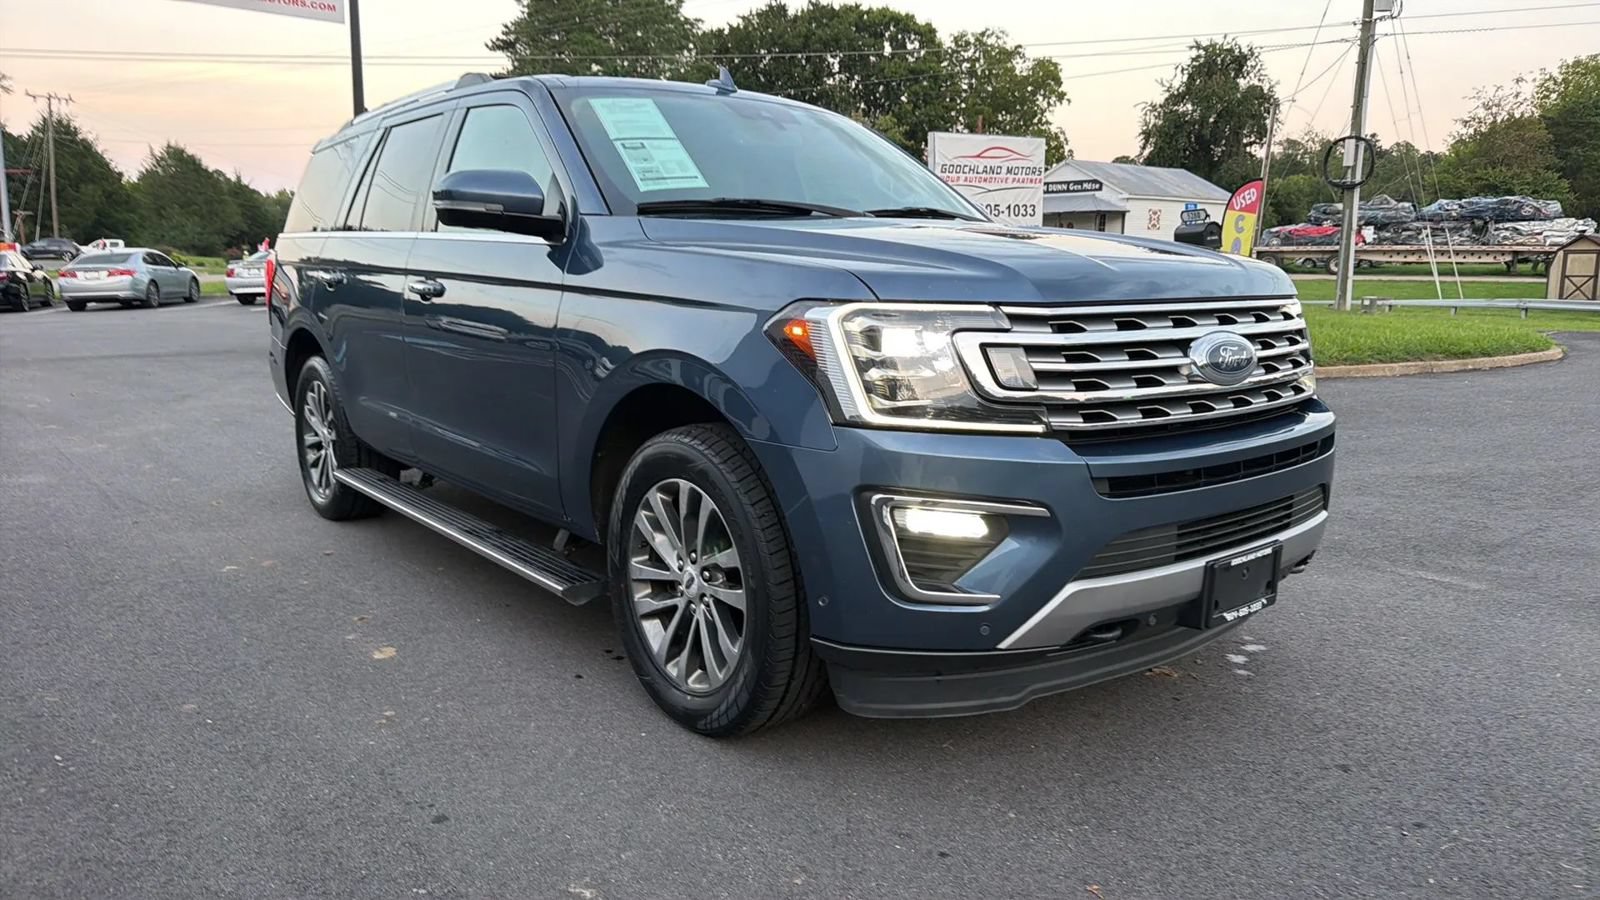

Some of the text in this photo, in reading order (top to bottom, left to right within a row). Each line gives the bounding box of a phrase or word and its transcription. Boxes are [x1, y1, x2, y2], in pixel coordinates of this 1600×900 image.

[940, 163, 1042, 177] GOOCHLAND MOTORS
[963, 176, 1008, 184] AUTOMOTIVE
[1011, 177, 1042, 185] PARTNER
[1232, 188, 1257, 210] USED
[981, 203, 1036, 218] 05-1033
[1219, 345, 1248, 368] Ford
